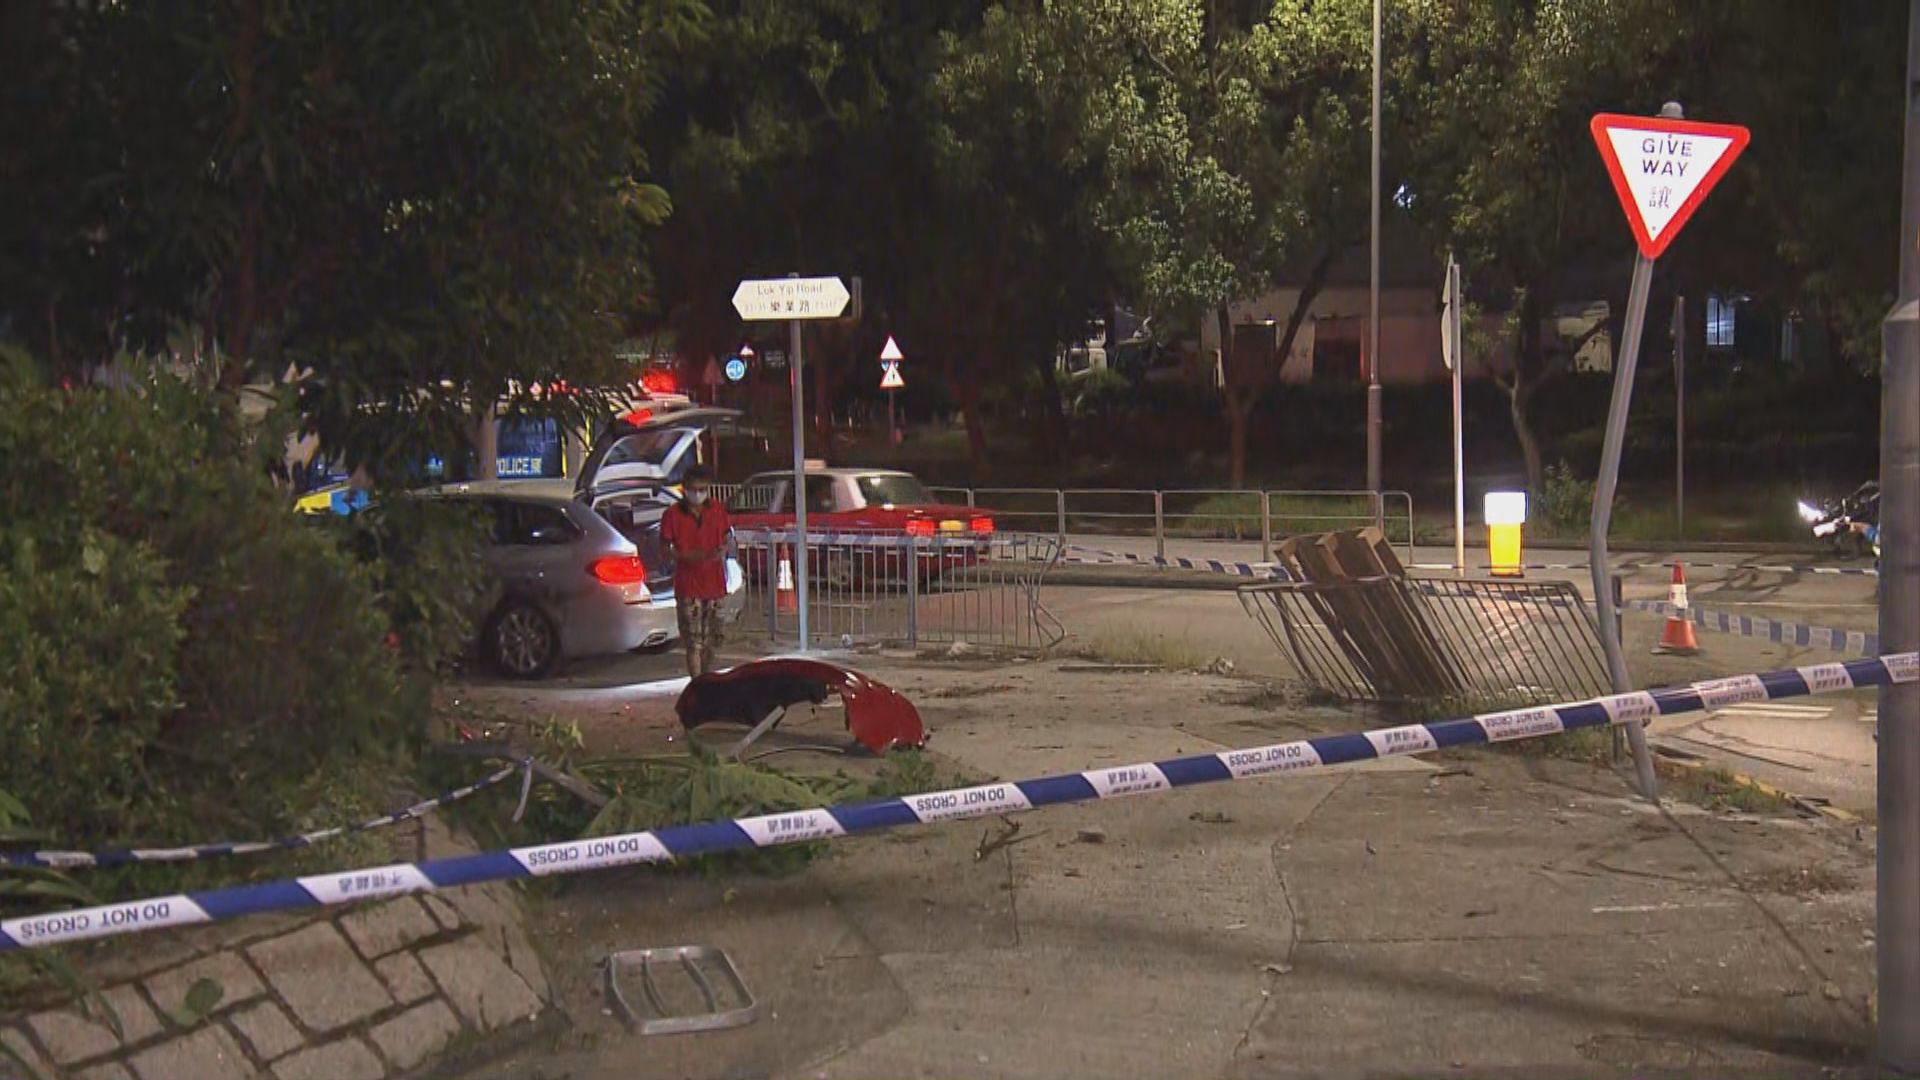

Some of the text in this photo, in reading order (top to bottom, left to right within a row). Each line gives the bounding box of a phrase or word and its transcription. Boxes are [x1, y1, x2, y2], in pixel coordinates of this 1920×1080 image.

[1642, 137, 1693, 157] GIVE
[1642, 159, 1688, 177] WAY
[796, 282, 822, 294] Road
[1266, 747, 1286, 761] NOT
[1286, 745, 1301, 757] DO
[1228, 752, 1262, 767] CROSS
[963, 791, 986, 805] NOT
[988, 788, 1005, 801] DO
[917, 794, 957, 811] CROSS
[587, 841, 615, 858] NOT
[618, 838, 639, 853] DO
[528, 846, 579, 866] CROSS
[20, 902, 170, 939] DO NOT CROSS
